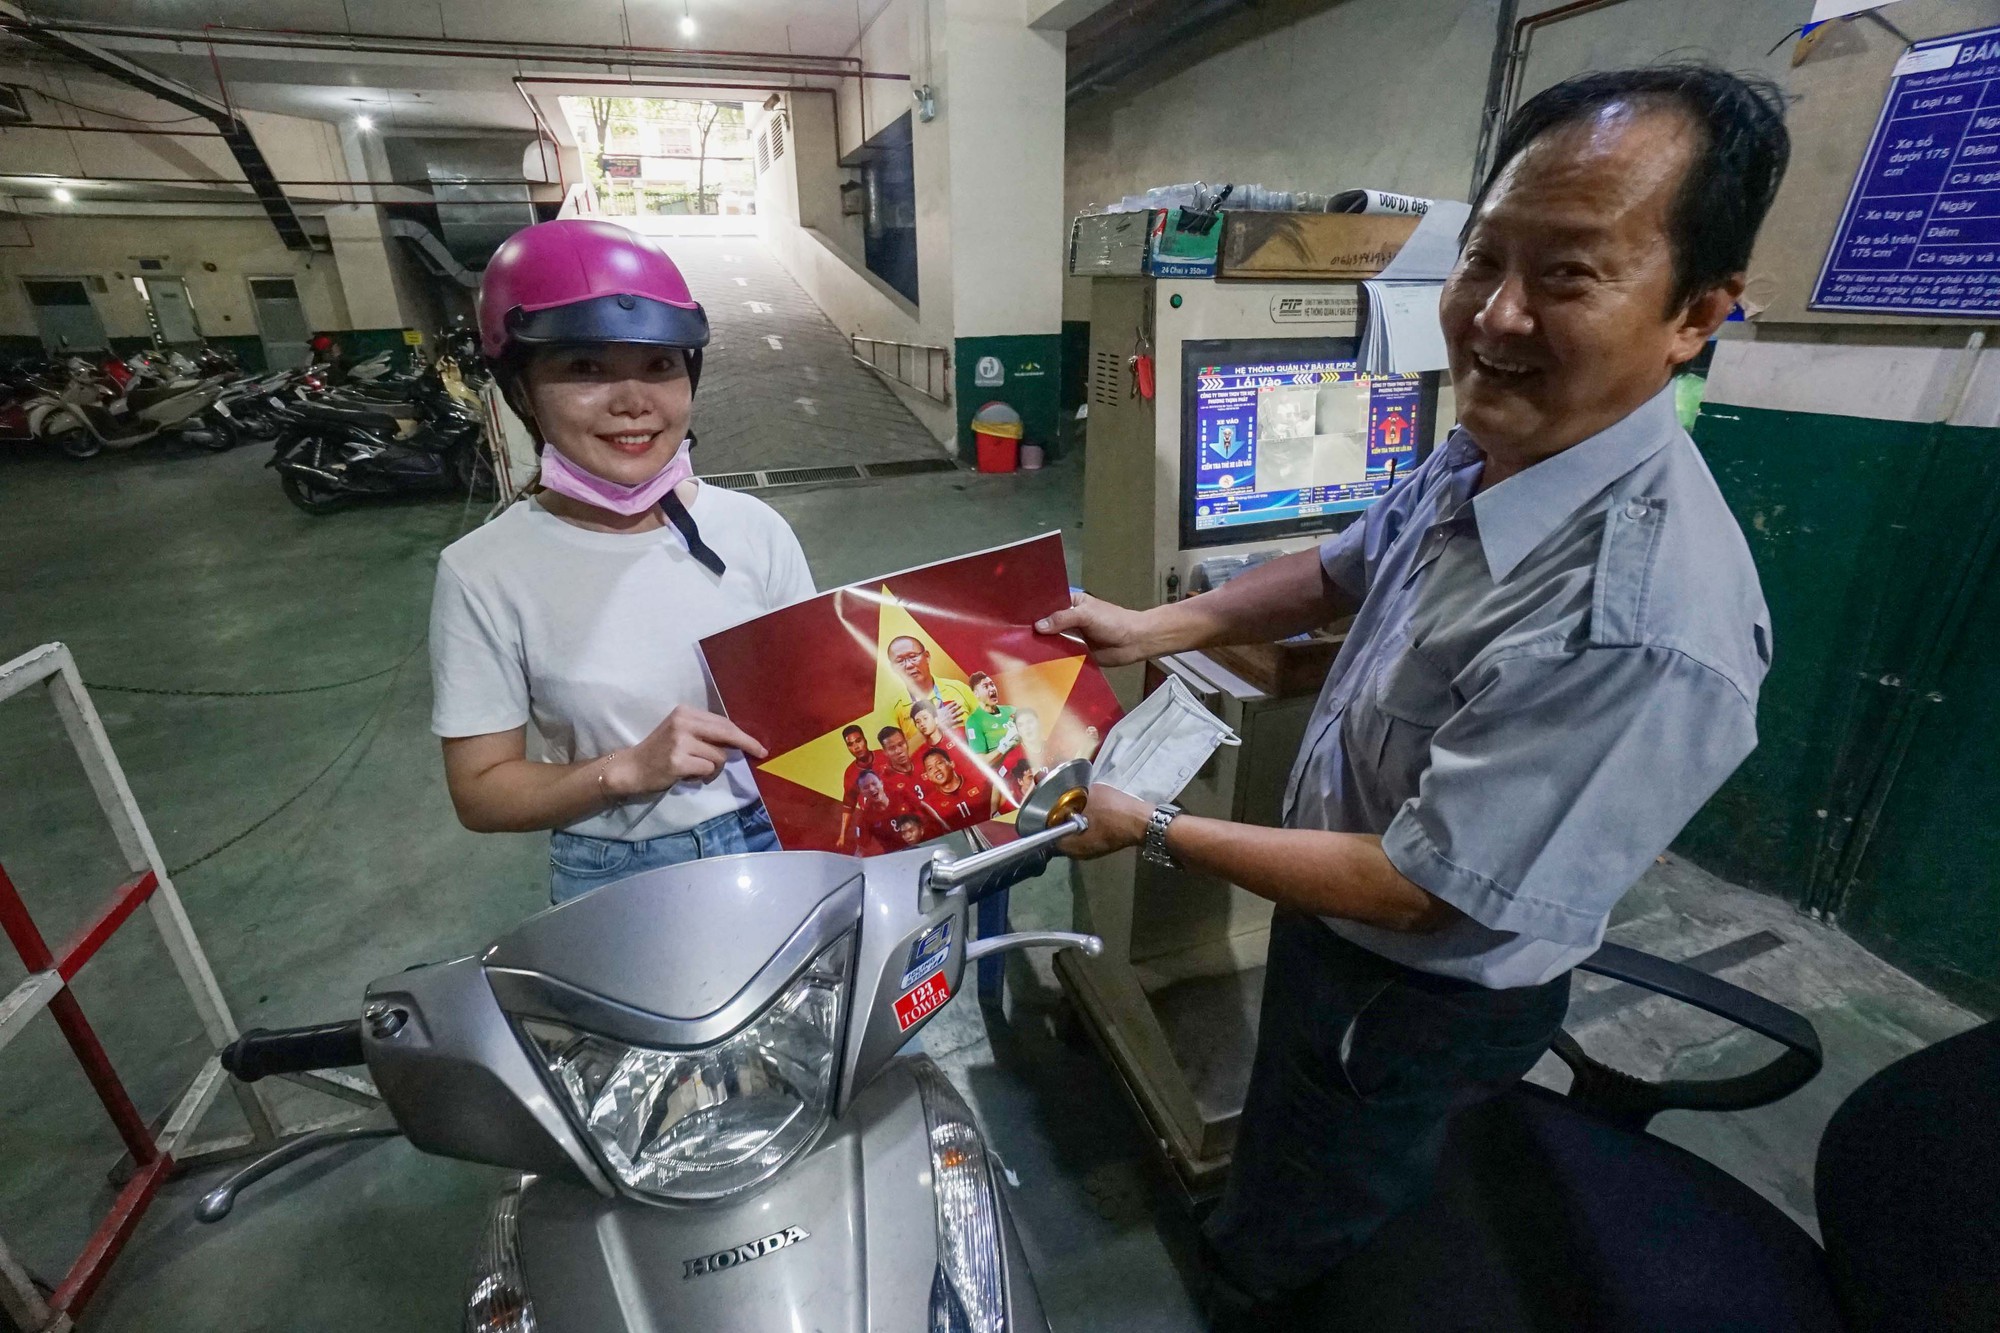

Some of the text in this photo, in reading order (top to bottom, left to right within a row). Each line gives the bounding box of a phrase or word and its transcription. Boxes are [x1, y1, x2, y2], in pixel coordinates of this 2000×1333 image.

[1912, 95, 1964, 110] Loại xe
[1895, 138, 1914, 150] Xe
[1915, 133, 1934, 148] số
[1889, 147, 1951, 164] dưới 175
[1962, 143, 1998, 157] Đêm
[1950, 172, 1971, 185] Cả
[1938, 200, 1977, 214] Ngày
[1865, 210, 1882, 221] Xe
[1883, 209, 1904, 221] tay
[1905, 210, 1924, 221] ga
[1854, 235, 1872, 245] Xe
[1872, 233, 1889, 245] số
[1891, 234, 1918, 245] trên
[1927, 226, 1960, 238] Đêm
[1851, 248, 1872, 258] 175
[1916, 251, 1995, 265] Cả ngày và
[1161, 266, 1170, 274] 24
[1170, 266, 1183, 274] Chai
[1189, 266, 1208, 275] 350ml
[1835, 273, 1856, 282] Khi
[1855, 273, 1876, 283] làm
[1876, 272, 1899, 283] mất
[1899, 274, 1919, 284] thẻ
[1919, 276, 1935, 284] xe
[1934, 274, 1966, 286] phải
[1832, 284, 1848, 293] Xe
[1881, 286, 1911, 296] ngày
[1822, 295, 1843, 304] qua
[1890, 295, 1910, 305] thu
[1235, 366, 1247, 376] HỆ
[1248, 364, 1276, 375] THỐNG
[1276, 362, 1299, 373] QUẢN
[1300, 362, 1310, 371] LÝ
[1311, 361, 1325, 370] BÃI
[1325, 361, 1336, 369] XE
[1236, 376, 1257, 389] Lối
[1258, 376, 1282, 388] Vào
[914, 784, 924, 800] 3
[956, 801, 972, 818] 11
[910, 981, 935, 1006] 123
[901, 987, 948, 1026] TOWER
[682, 1224, 811, 1280] HONDA
